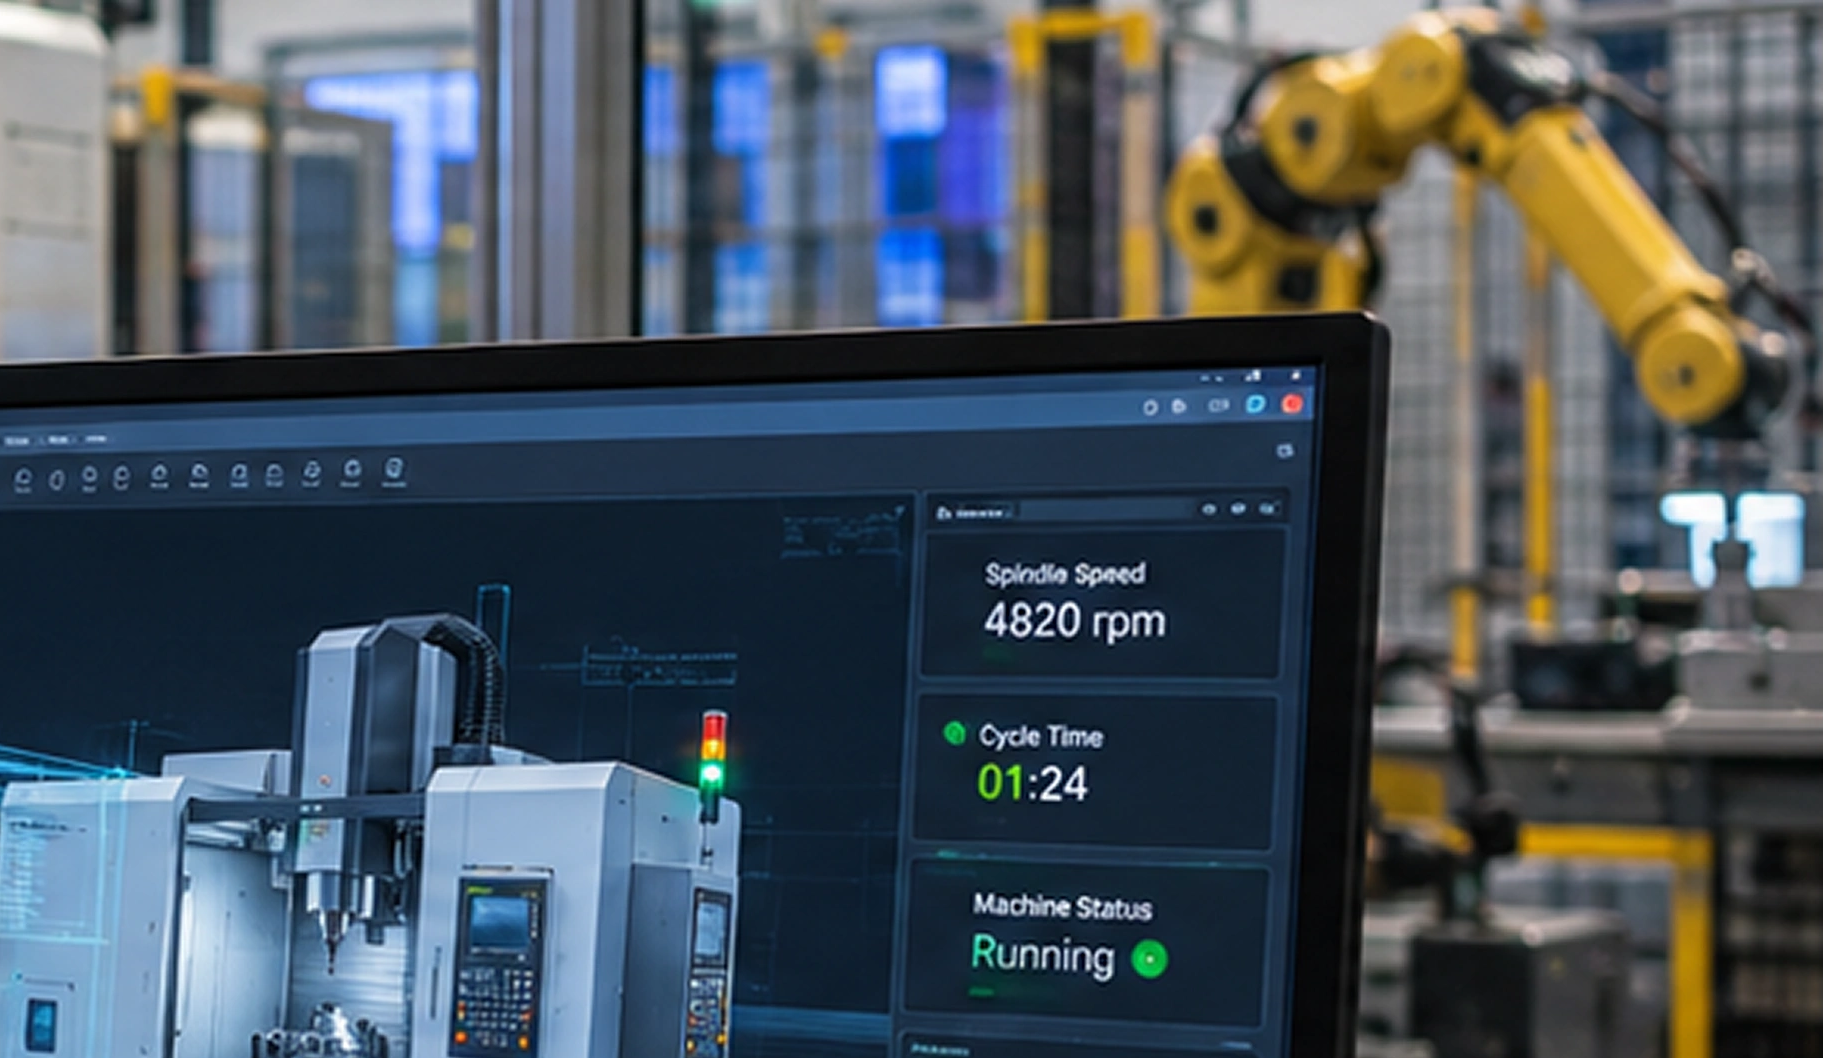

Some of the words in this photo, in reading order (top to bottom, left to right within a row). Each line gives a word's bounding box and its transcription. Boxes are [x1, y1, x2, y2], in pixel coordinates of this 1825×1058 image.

[985, 562, 1068, 588] Spindle
[1074, 562, 1147, 589] Speed
[984, 601, 1082, 639] 4820
[1092, 608, 1166, 645] rpm
[979, 724, 1041, 752] Cycle
[1046, 724, 1104, 748] Time
[977, 762, 1088, 802] 01:24
[974, 892, 1071, 918] Machine
[1074, 895, 1153, 922] Status
[971, 933, 1115, 982] Running
